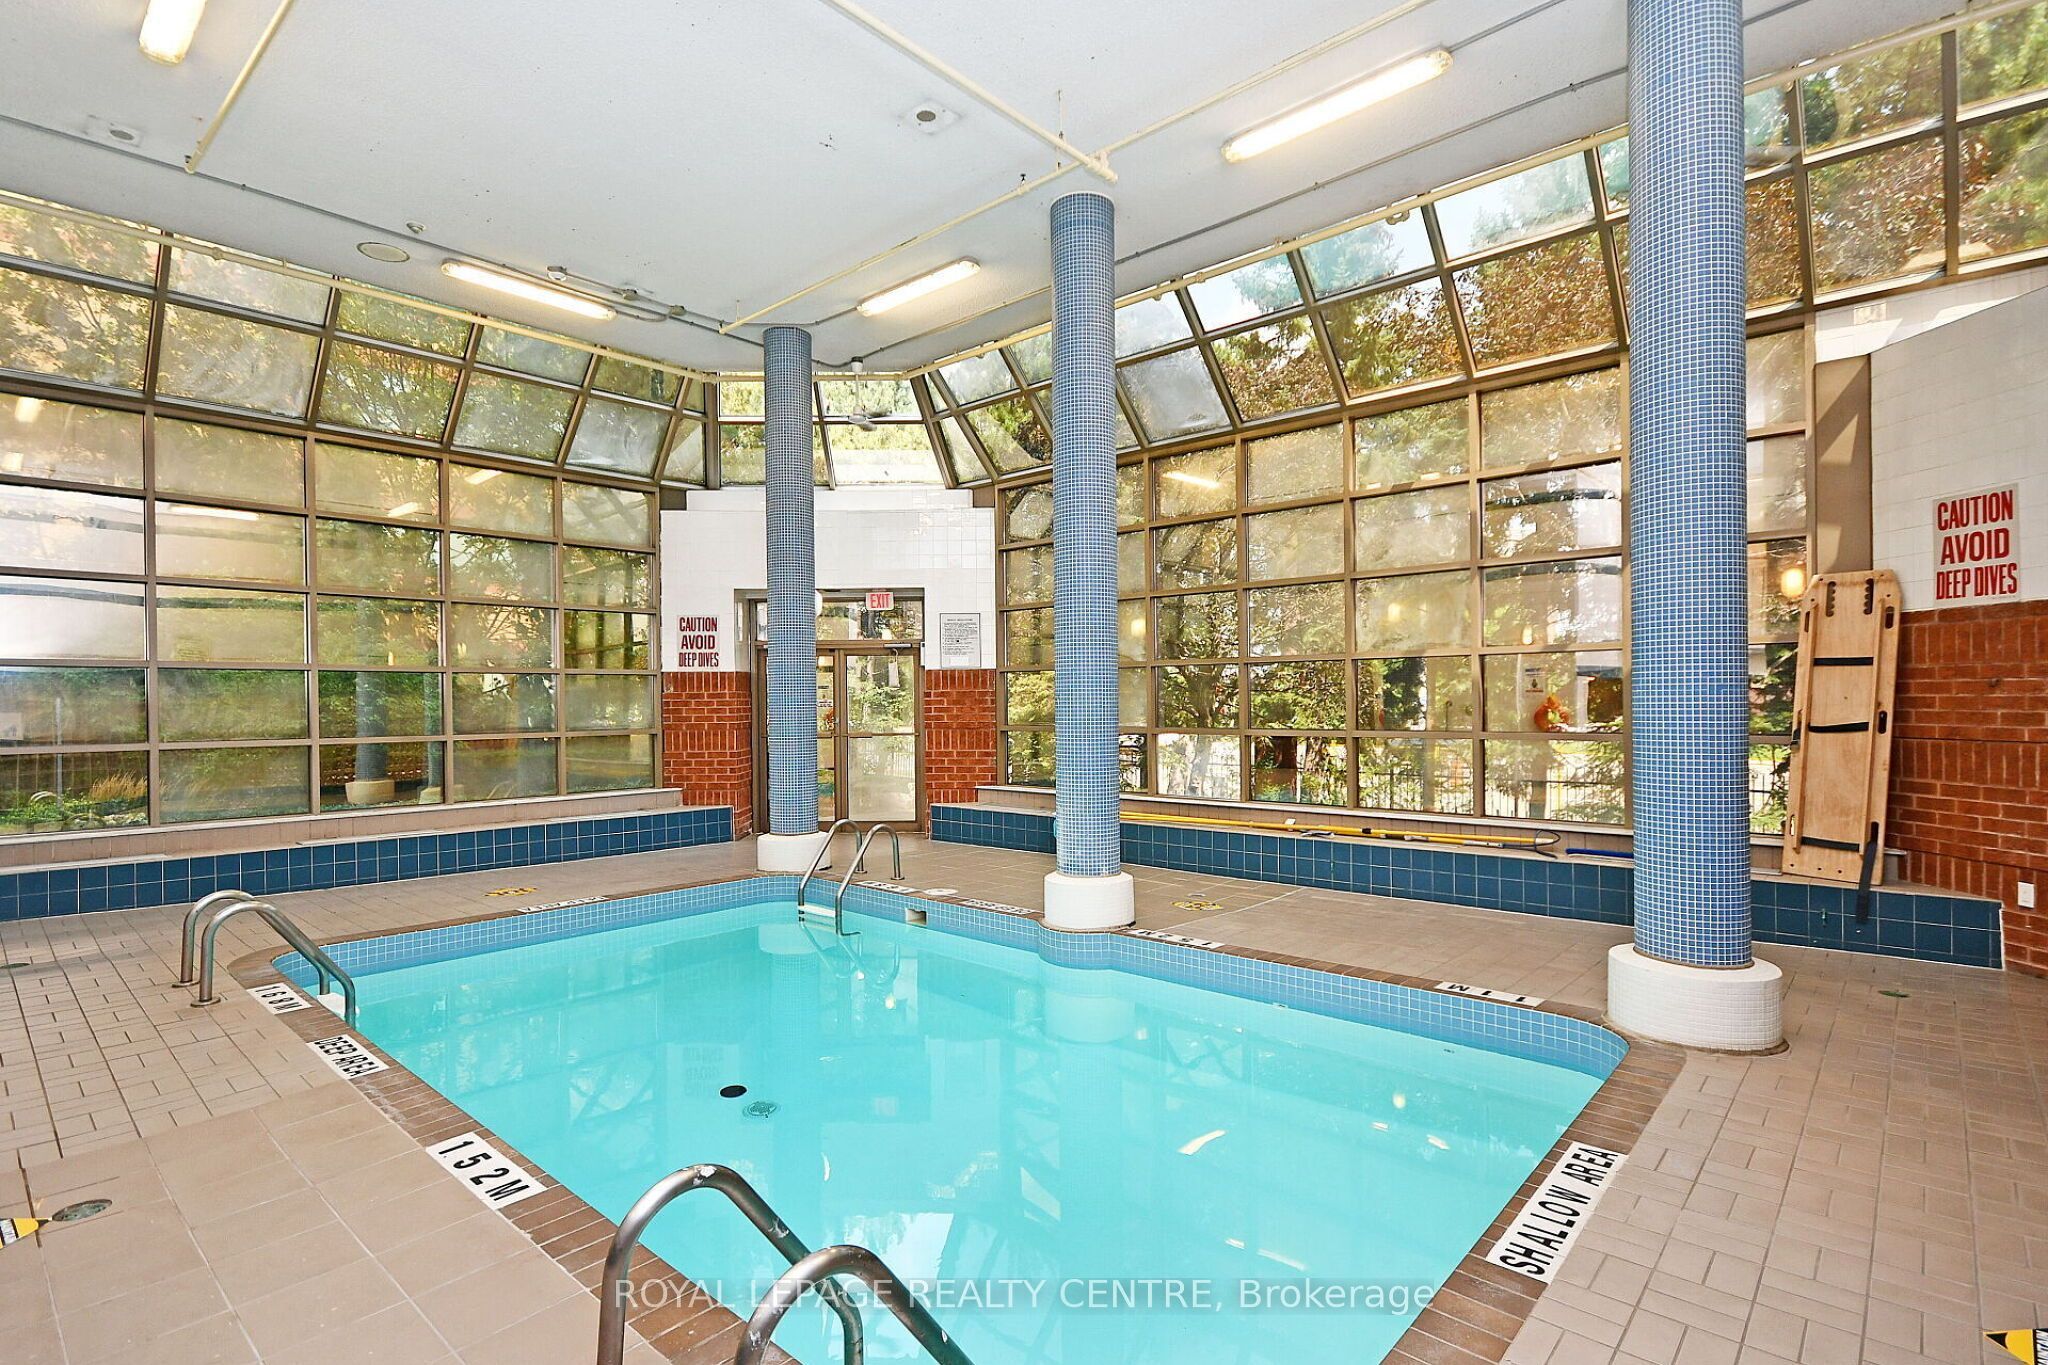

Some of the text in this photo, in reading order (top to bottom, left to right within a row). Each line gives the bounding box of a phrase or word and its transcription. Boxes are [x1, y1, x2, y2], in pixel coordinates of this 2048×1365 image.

[1937, 490, 2013, 531] CAUTION
[1941, 528, 2010, 565] AVOID
[1936, 562, 2018, 600] DEEP DIVES
[870, 593, 890, 609] EXIT
[679, 616, 718, 632] CAUTION
[681, 634, 716, 650] AVOID
[678, 652, 719, 667] DEEP DIVES
[313, 1036, 380, 1078] DEEP AREA
[1499, 1147, 1619, 1275] SHALLOW AREA
